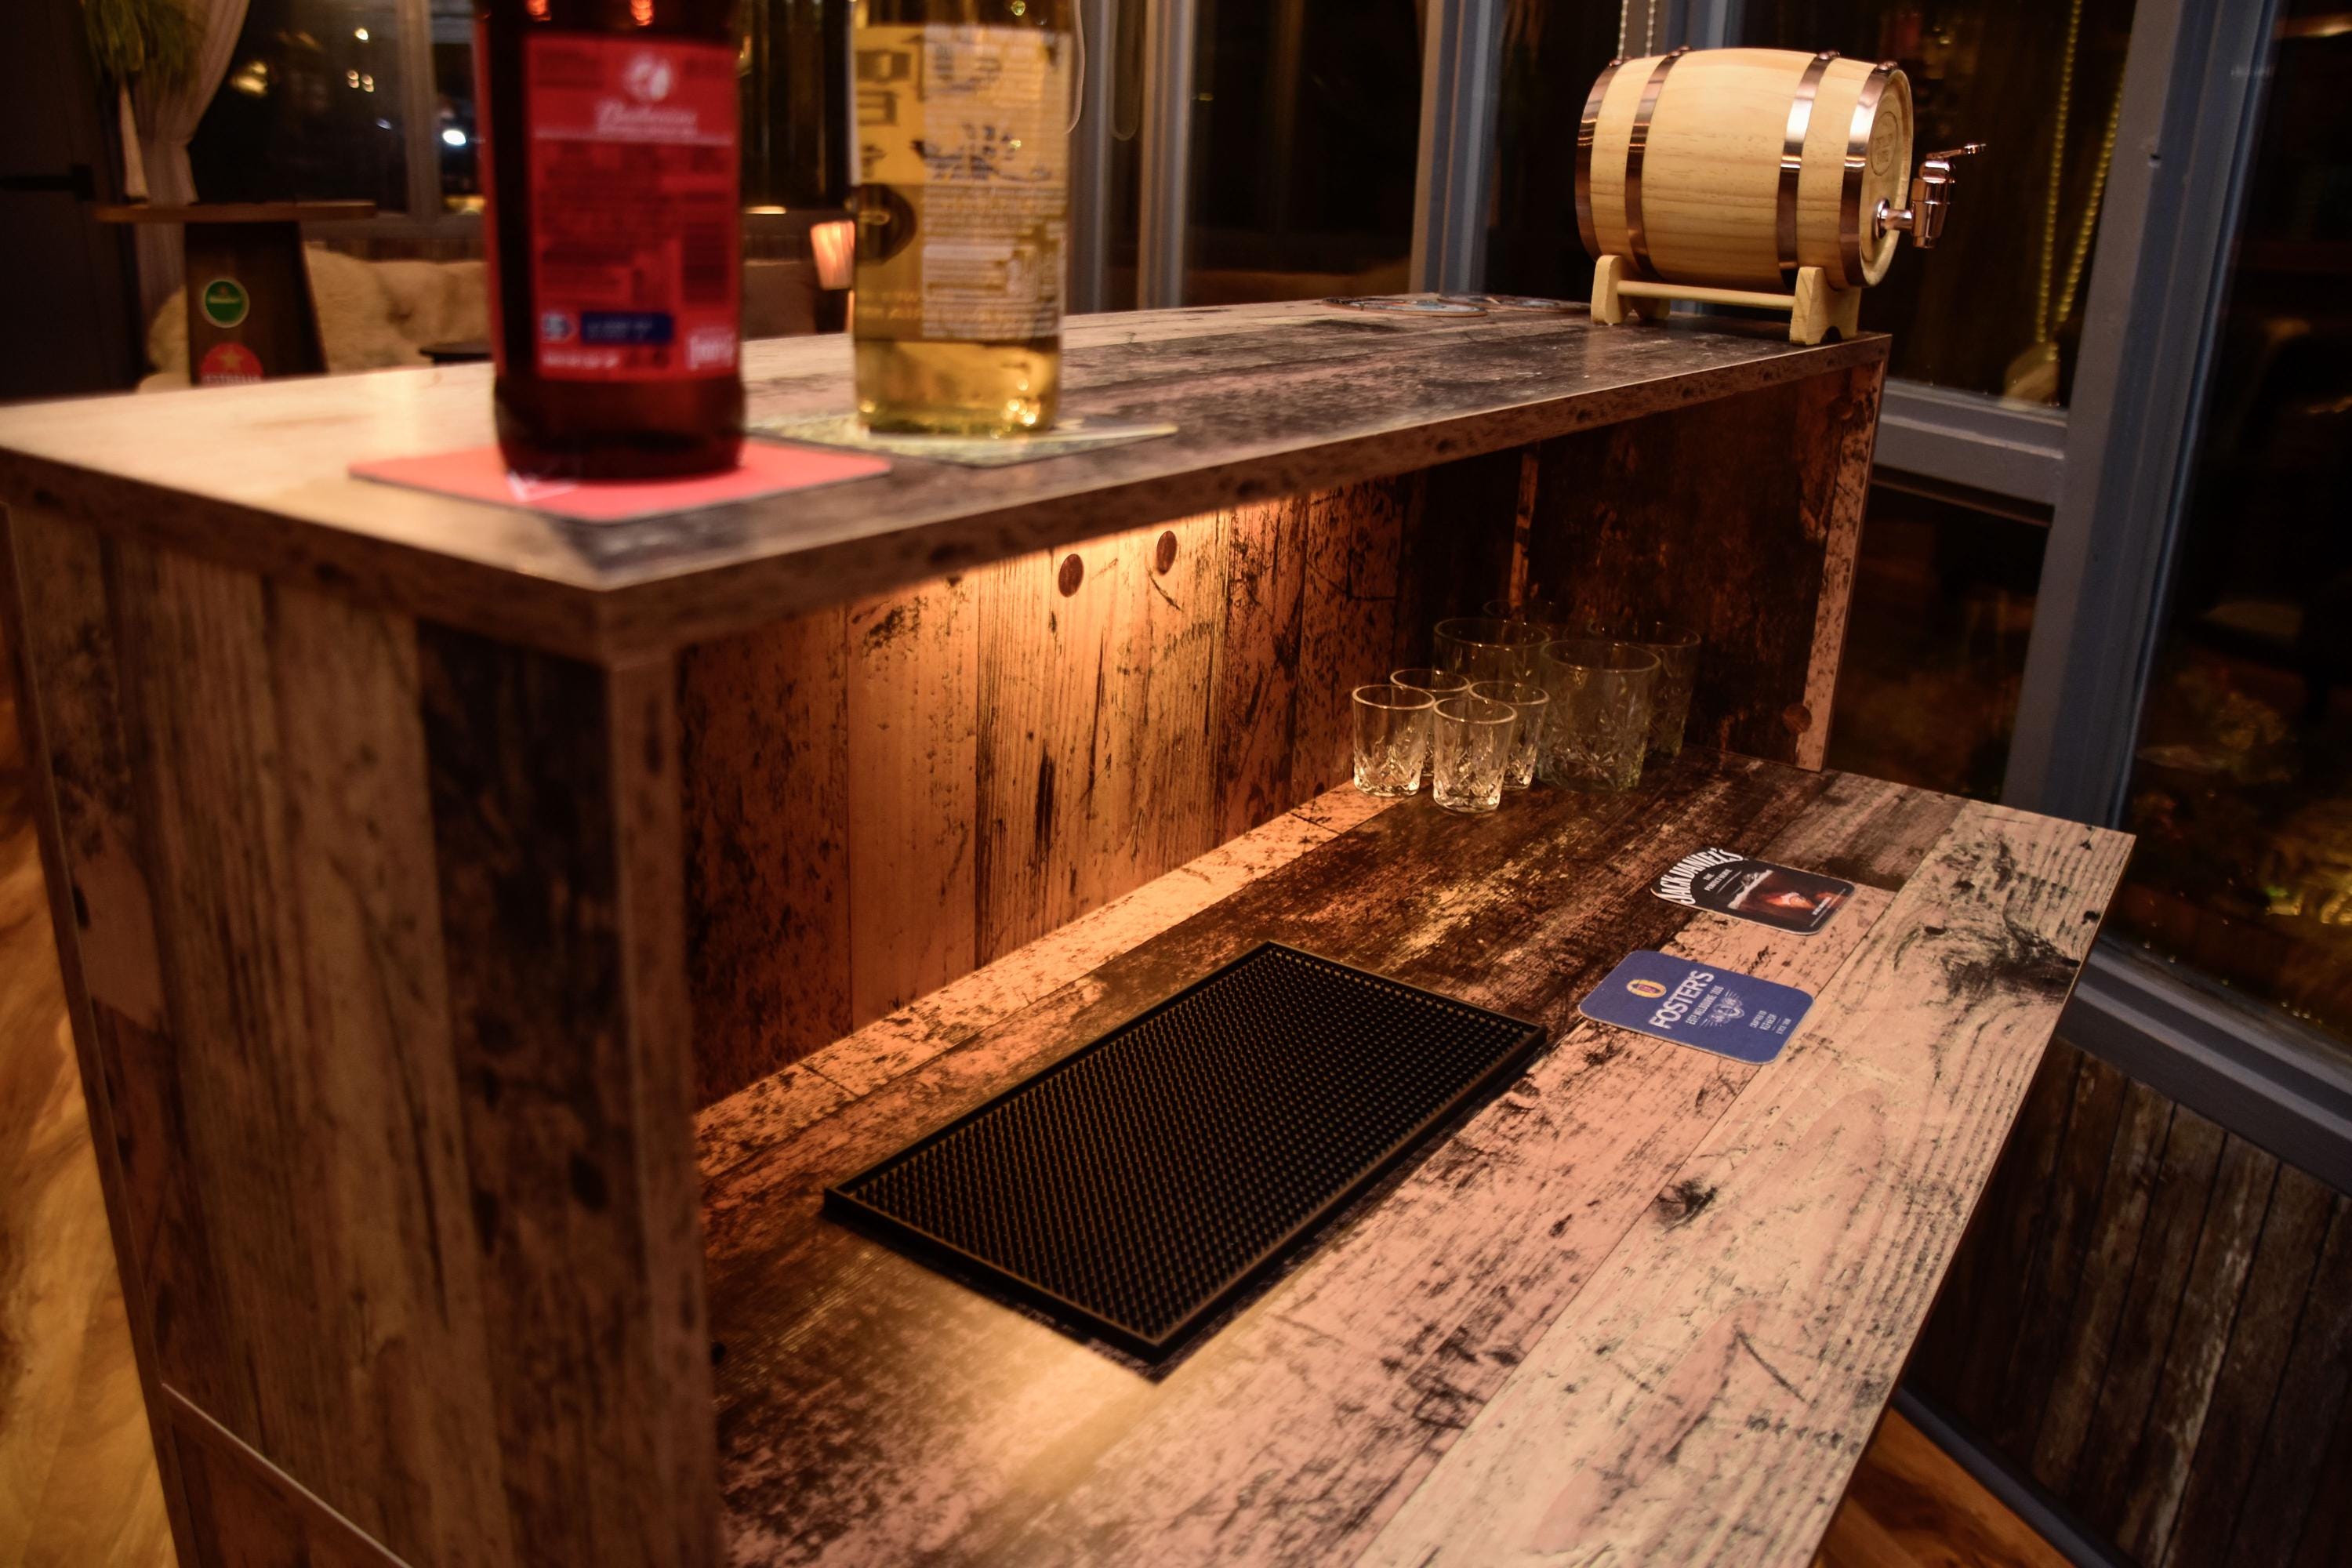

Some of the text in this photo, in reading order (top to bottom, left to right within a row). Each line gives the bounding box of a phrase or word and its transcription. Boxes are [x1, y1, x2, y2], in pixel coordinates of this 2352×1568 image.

[1657, 848, 1744, 905] JACK DANIEL'S
[1648, 971, 1715, 1029] FOSTER'S
